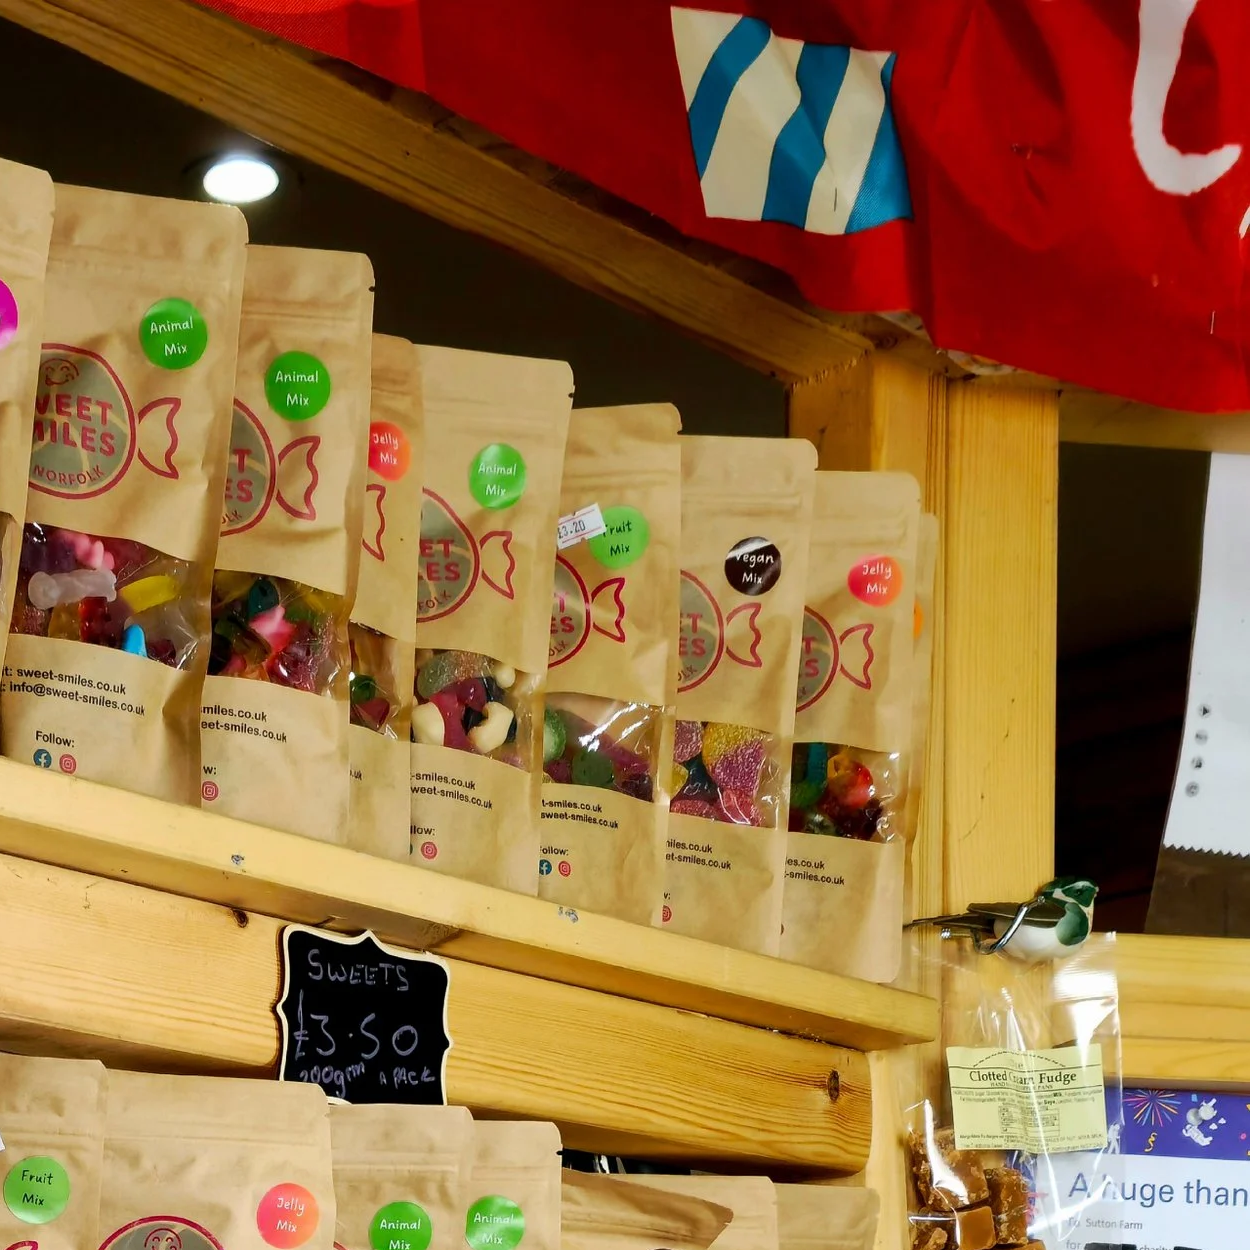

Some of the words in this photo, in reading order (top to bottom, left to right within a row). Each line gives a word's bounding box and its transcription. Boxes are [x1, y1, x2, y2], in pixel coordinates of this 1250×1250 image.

[150, 316, 194, 335] Animal
[164, 343, 188, 357] Mix
[275, 370, 319, 383] Animal
[286, 393, 309, 407] Mix
[372, 432, 399, 449] Jelly
[379, 451, 398, 465] Mix
[34, 463, 105, 485] NORFOLK
[478, 463, 517, 477] Animal
[485, 484, 506, 497] Mix
[610, 543, 630, 556] Mix
[735, 552, 774, 569] Vegan
[742, 572, 763, 584] Mix
[862, 563, 892, 579] Jelly
[866, 583, 888, 594] Mix
[16, 668, 126, 695] sweet-smiles.co.uk
[9, 682, 145, 716] info@sweet-smiles.co.uk
[201, 704, 268, 723] miles.co.uk
[35, 730, 76, 748] Follow:
[307, 949, 409, 991] SWEETS
[393, 1066, 436, 1089] PACK
[969, 1071, 1007, 1082] Clotted
[1039, 1071, 1077, 1085] Fudge
[21, 1169, 54, 1186] Fruit
[1068, 1172, 1091, 1198] A
[1183, 1179, 1250, 1207] than
[22, 1193, 45, 1206] Mix
[276, 1197, 305, 1217] Jelly
[276, 1219, 298, 1233] Mix
[379, 1219, 421, 1231] Animal
[473, 1214, 515, 1225] Animal
[1085, 1218, 1117, 1229] Sutton
[1119, 1220, 1143, 1230] Farm
[389, 1240, 410, 1250] Mix
[481, 1233, 503, 1245] Mix
[1066, 1239, 1082, 1250] for
